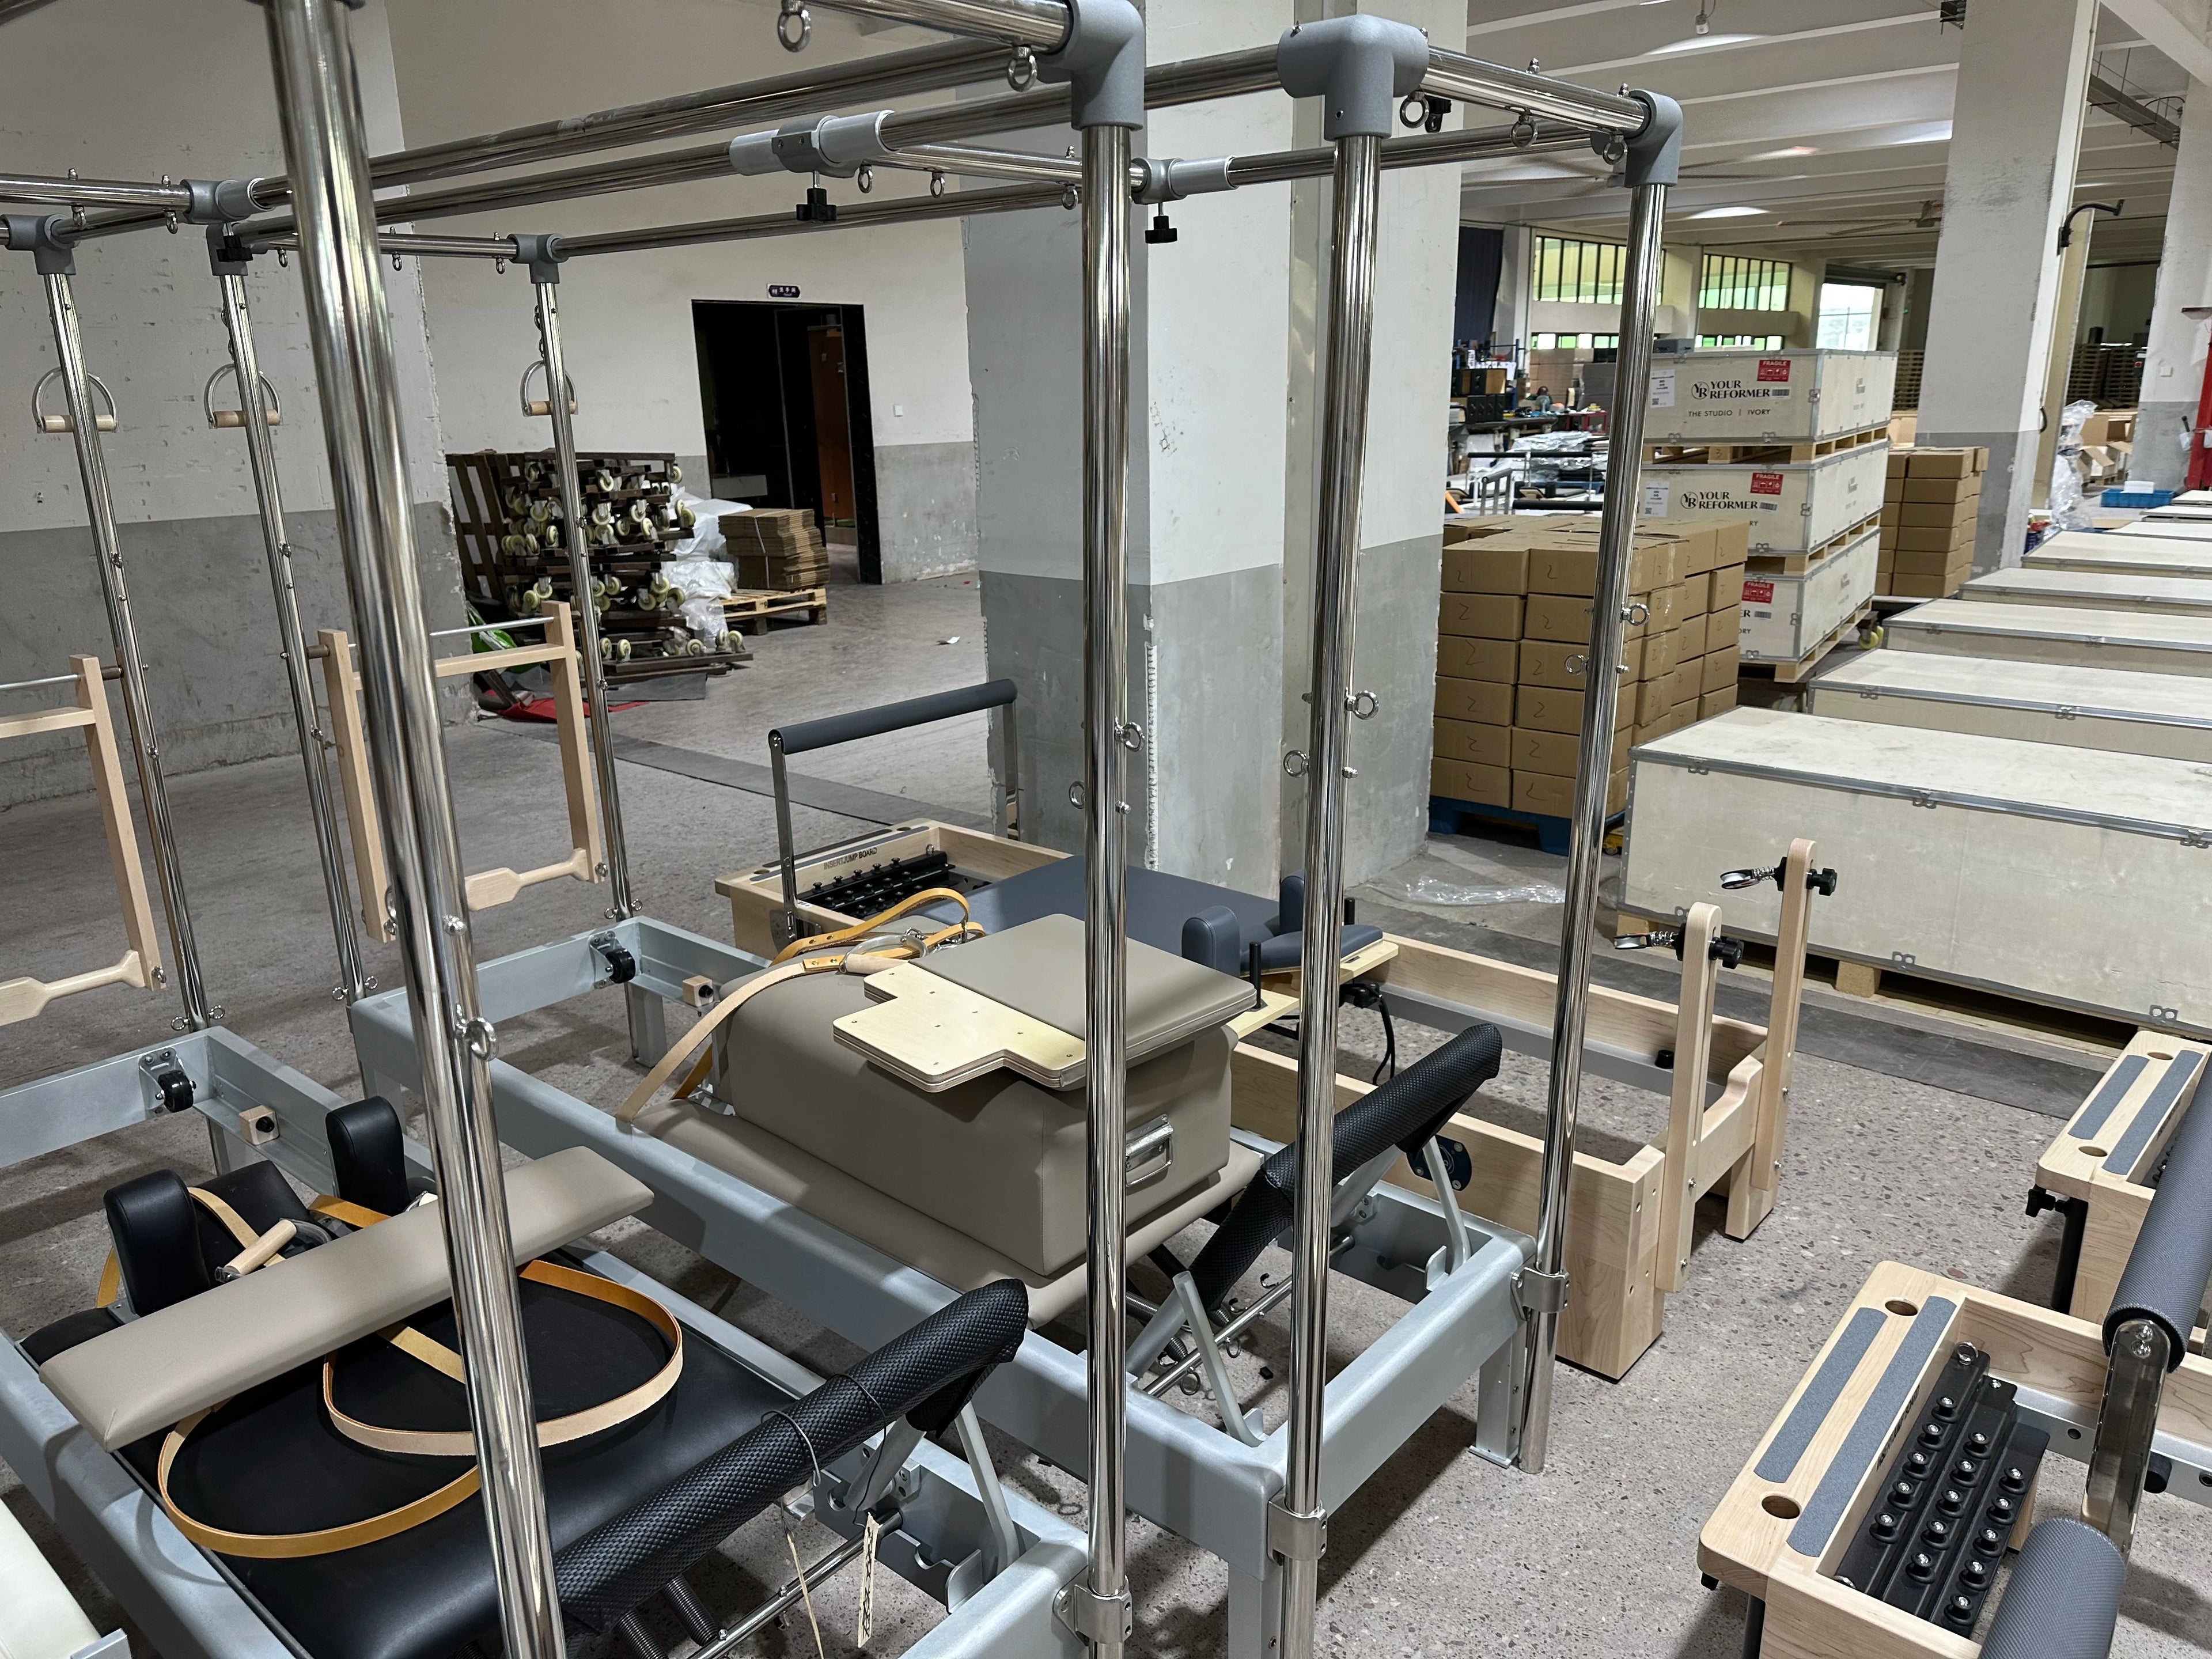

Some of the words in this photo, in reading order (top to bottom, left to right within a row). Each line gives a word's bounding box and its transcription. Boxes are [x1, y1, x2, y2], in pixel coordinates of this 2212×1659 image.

[1710, 380, 1741, 389] YOUR
[1710, 389, 1770, 399] REFORMER
[1699, 491, 1729, 499] YOUR
[1699, 501, 1758, 509] REFORMER
[1459, 603, 1469, 620] 2
[1543, 615, 1552, 630] 2
[1532, 659, 1544, 676] 2
[1467, 696, 1482, 712] 2
[1533, 701, 1546, 718] 2
[1529, 740, 1542, 759] 2
[824, 858, 843, 870] INSERT
[843, 853, 858, 863] JUMP
[859, 847, 877, 859] BOARD
